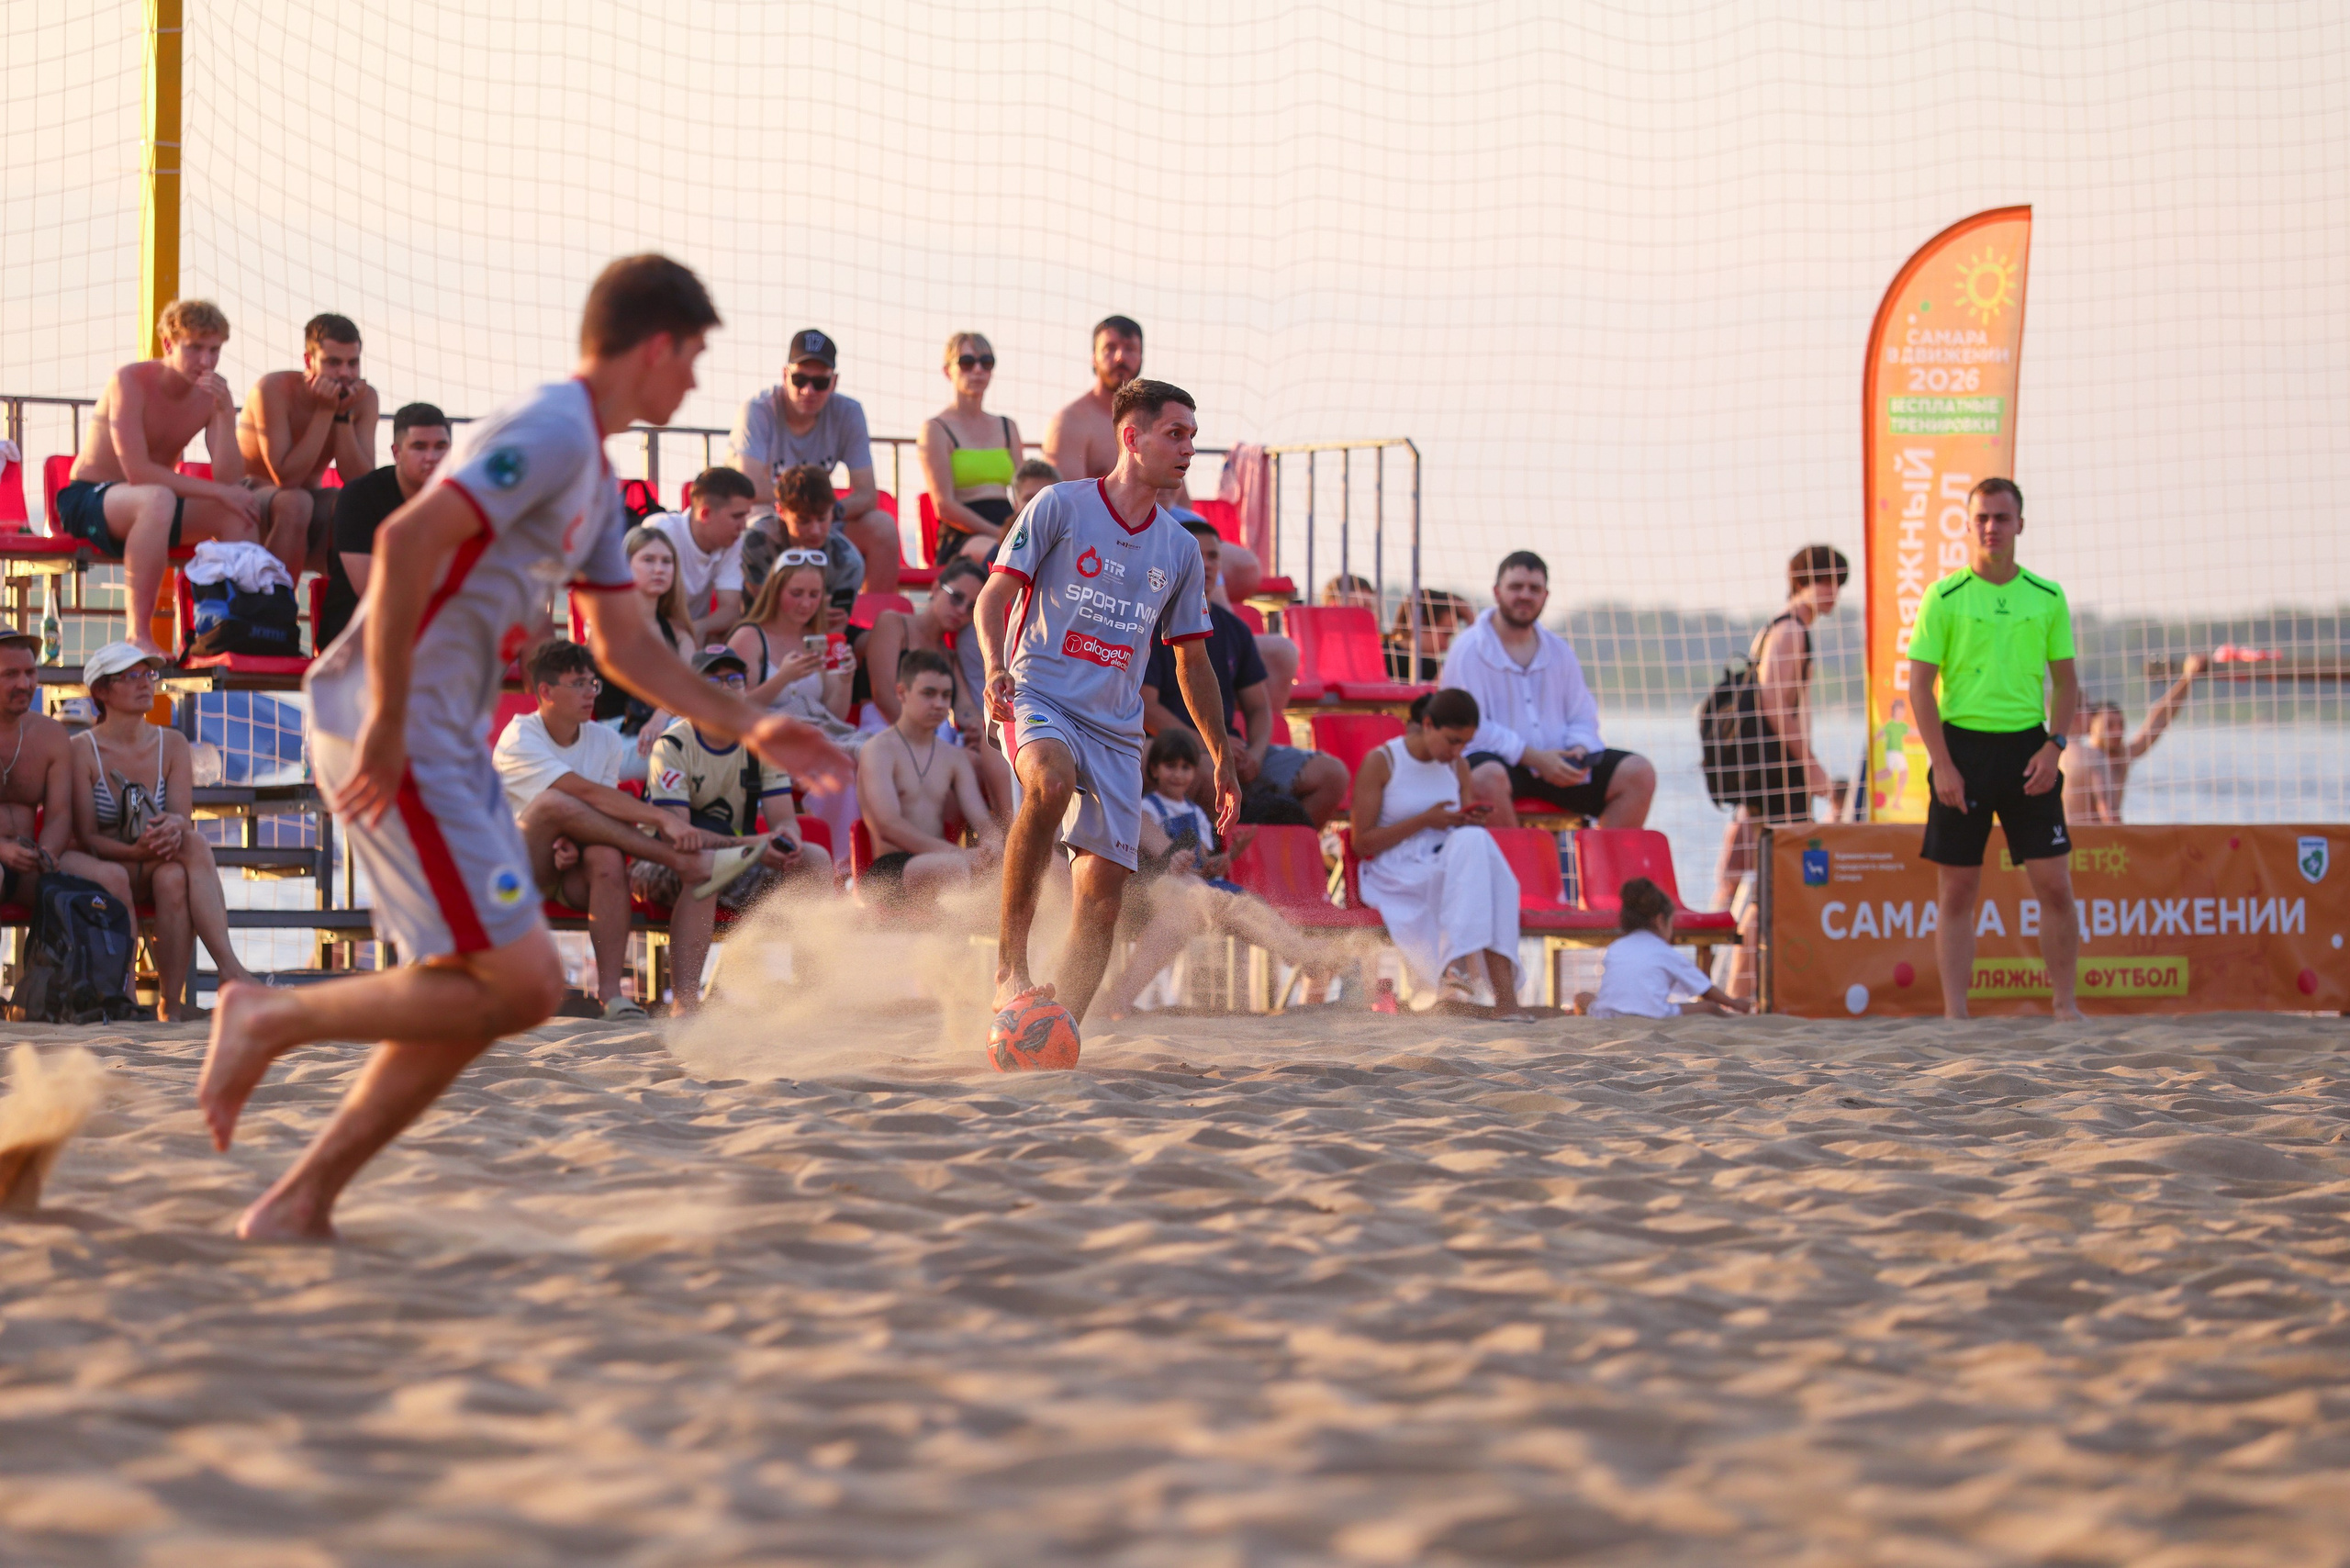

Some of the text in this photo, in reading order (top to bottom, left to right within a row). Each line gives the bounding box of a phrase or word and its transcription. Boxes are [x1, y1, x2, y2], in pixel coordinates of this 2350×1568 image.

[1907, 329, 1987, 345] САМАРА
[1886, 346, 2009, 364] В ДВИЖЕНИИ
[1908, 367, 1980, 392] 2026
[1891, 398, 1999, 414] БЕСПЛАТНЫЕ
[1891, 416, 1997, 432] ТРЕНИРОВКИ
[1065, 584, 1131, 616] SPORT
[1079, 607, 1145, 634] Самара
[1821, 899, 2006, 940] САМАА
[2085, 967, 2178, 988] ФУТБОЛ
